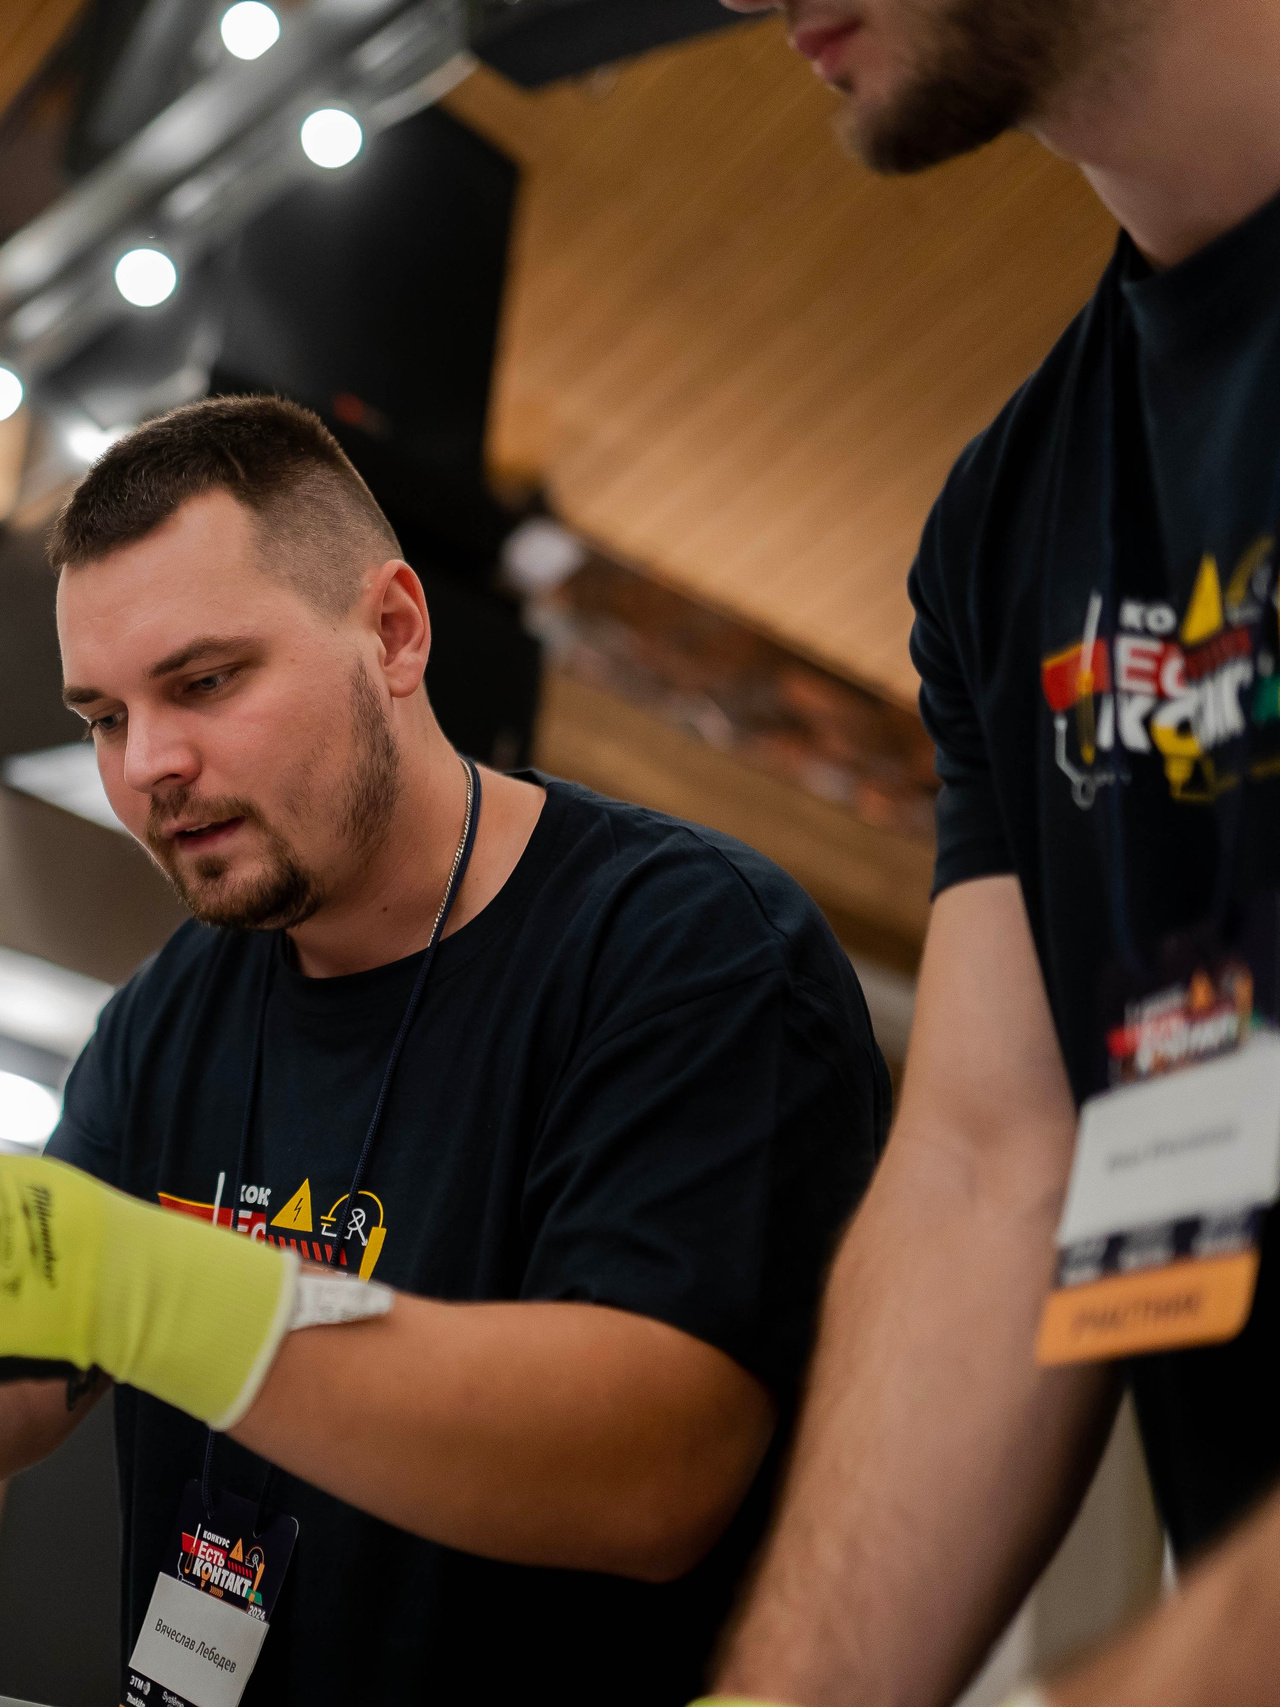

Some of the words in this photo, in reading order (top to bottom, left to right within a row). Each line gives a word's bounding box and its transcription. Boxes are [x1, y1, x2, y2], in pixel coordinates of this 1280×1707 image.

[202, 1529, 231, 1549] КОНКУРС
[192, 1557, 253, 1599] КОНТАКТ
[247, 1605, 266, 1622] 2024
[154, 1618, 196, 1651] Вячеслав
[195, 1641, 237, 1674] Лебедев
